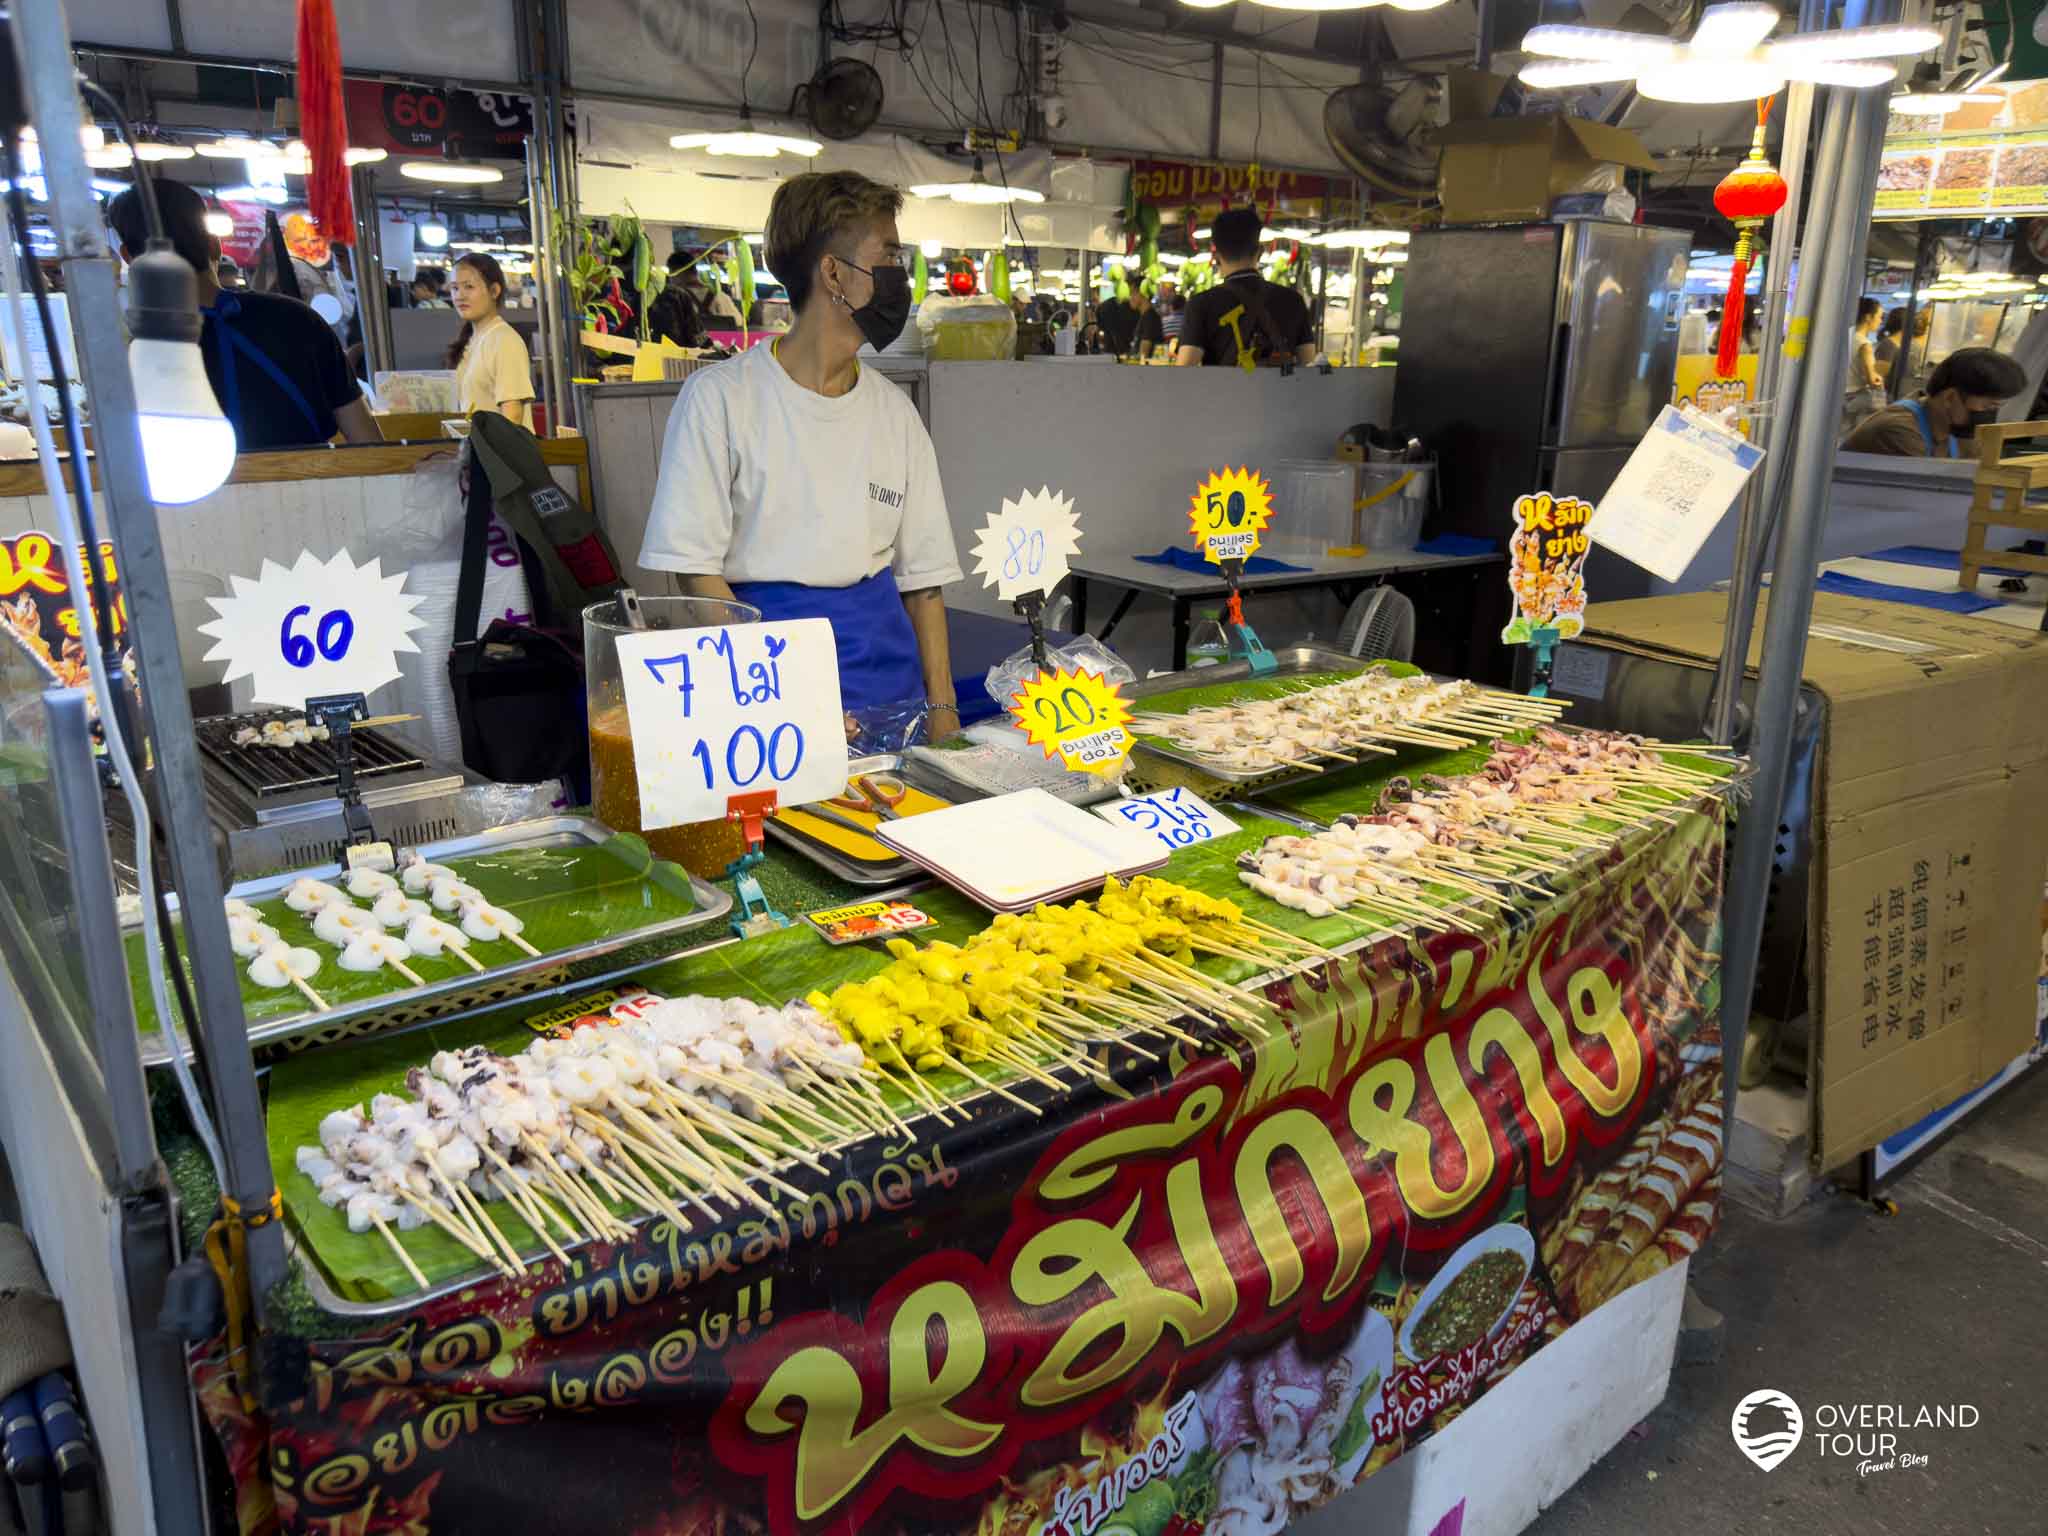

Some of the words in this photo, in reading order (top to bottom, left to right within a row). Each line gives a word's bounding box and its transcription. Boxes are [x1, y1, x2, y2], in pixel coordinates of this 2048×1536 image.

[393, 92, 447, 128] 60
[878, 487, 904, 508] ONLY
[1519, 494, 1592, 532] หมึก
[1002, 526, 1046, 580] 80
[1208, 533, 1254, 546] Selling
[1217, 546, 1247, 556] Top
[1545, 529, 1588, 558] ย่าง
[280, 604, 355, 668] 60
[692, 721, 805, 790] 100
[1061, 728, 1124, 753] Selling
[1081, 746, 1121, 762] Top
[1156, 822, 1213, 849] 100
[883, 910, 923, 924] 15
[1861, 892, 1882, 1049] 节能省电
[1885, 885, 1905, 1037] 超强制冰
[541, 1138, 960, 1336] ย่างใหม่ทุกวัน
[744, 932, 1646, 1521] หมึกย่าง
